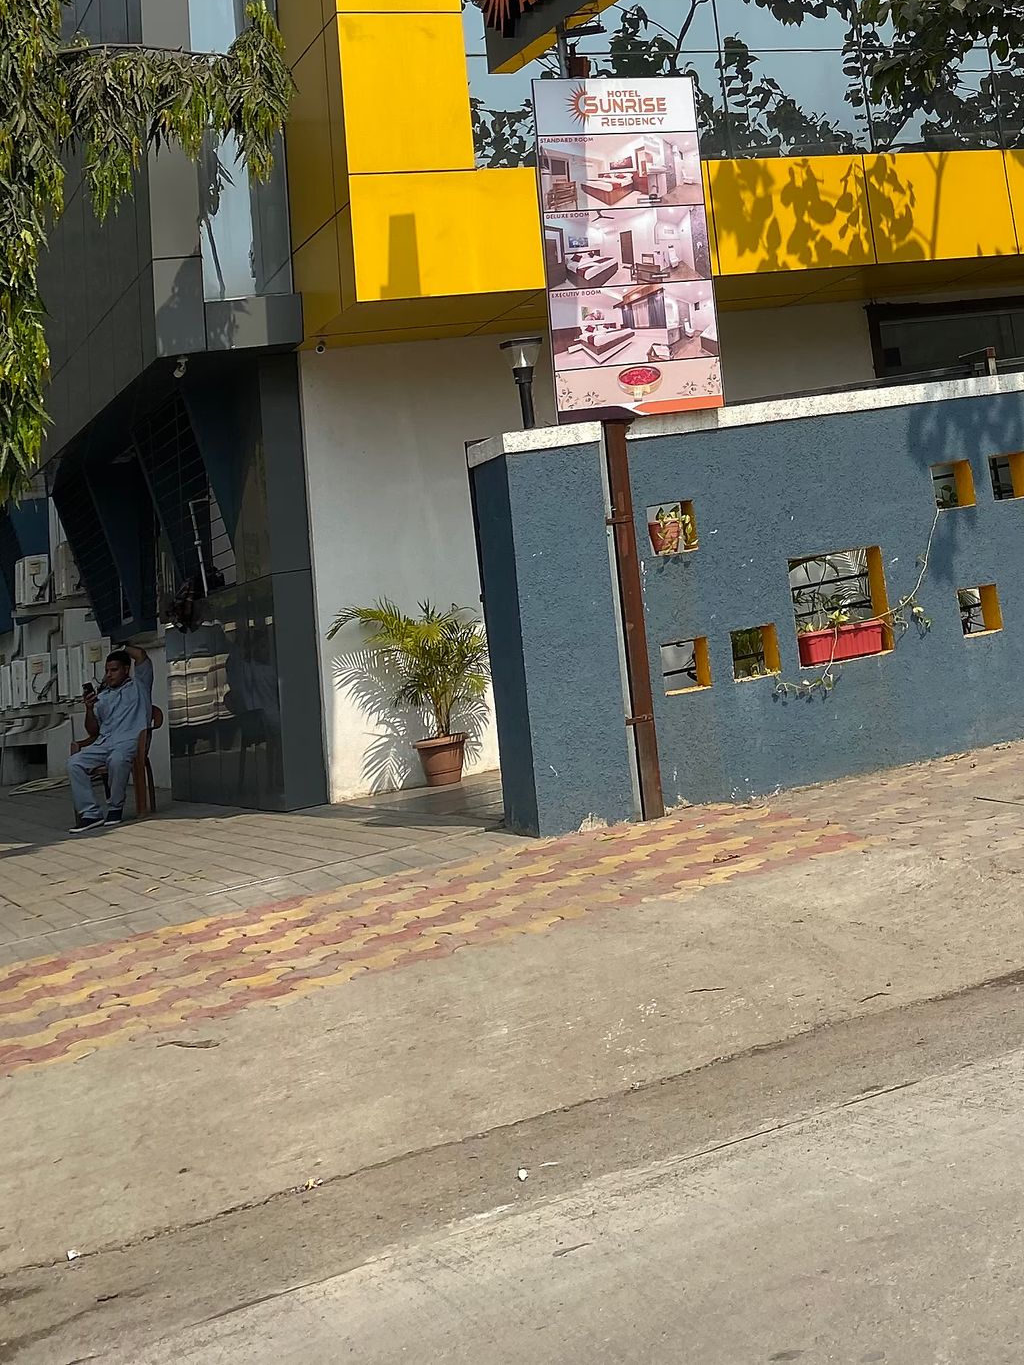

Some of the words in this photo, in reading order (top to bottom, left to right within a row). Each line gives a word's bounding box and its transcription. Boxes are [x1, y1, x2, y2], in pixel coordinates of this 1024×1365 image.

[607, 90, 641, 98] HOTEL
[584, 96, 667, 114] SUNRISE
[601, 117, 664, 127] RESIDENCY
